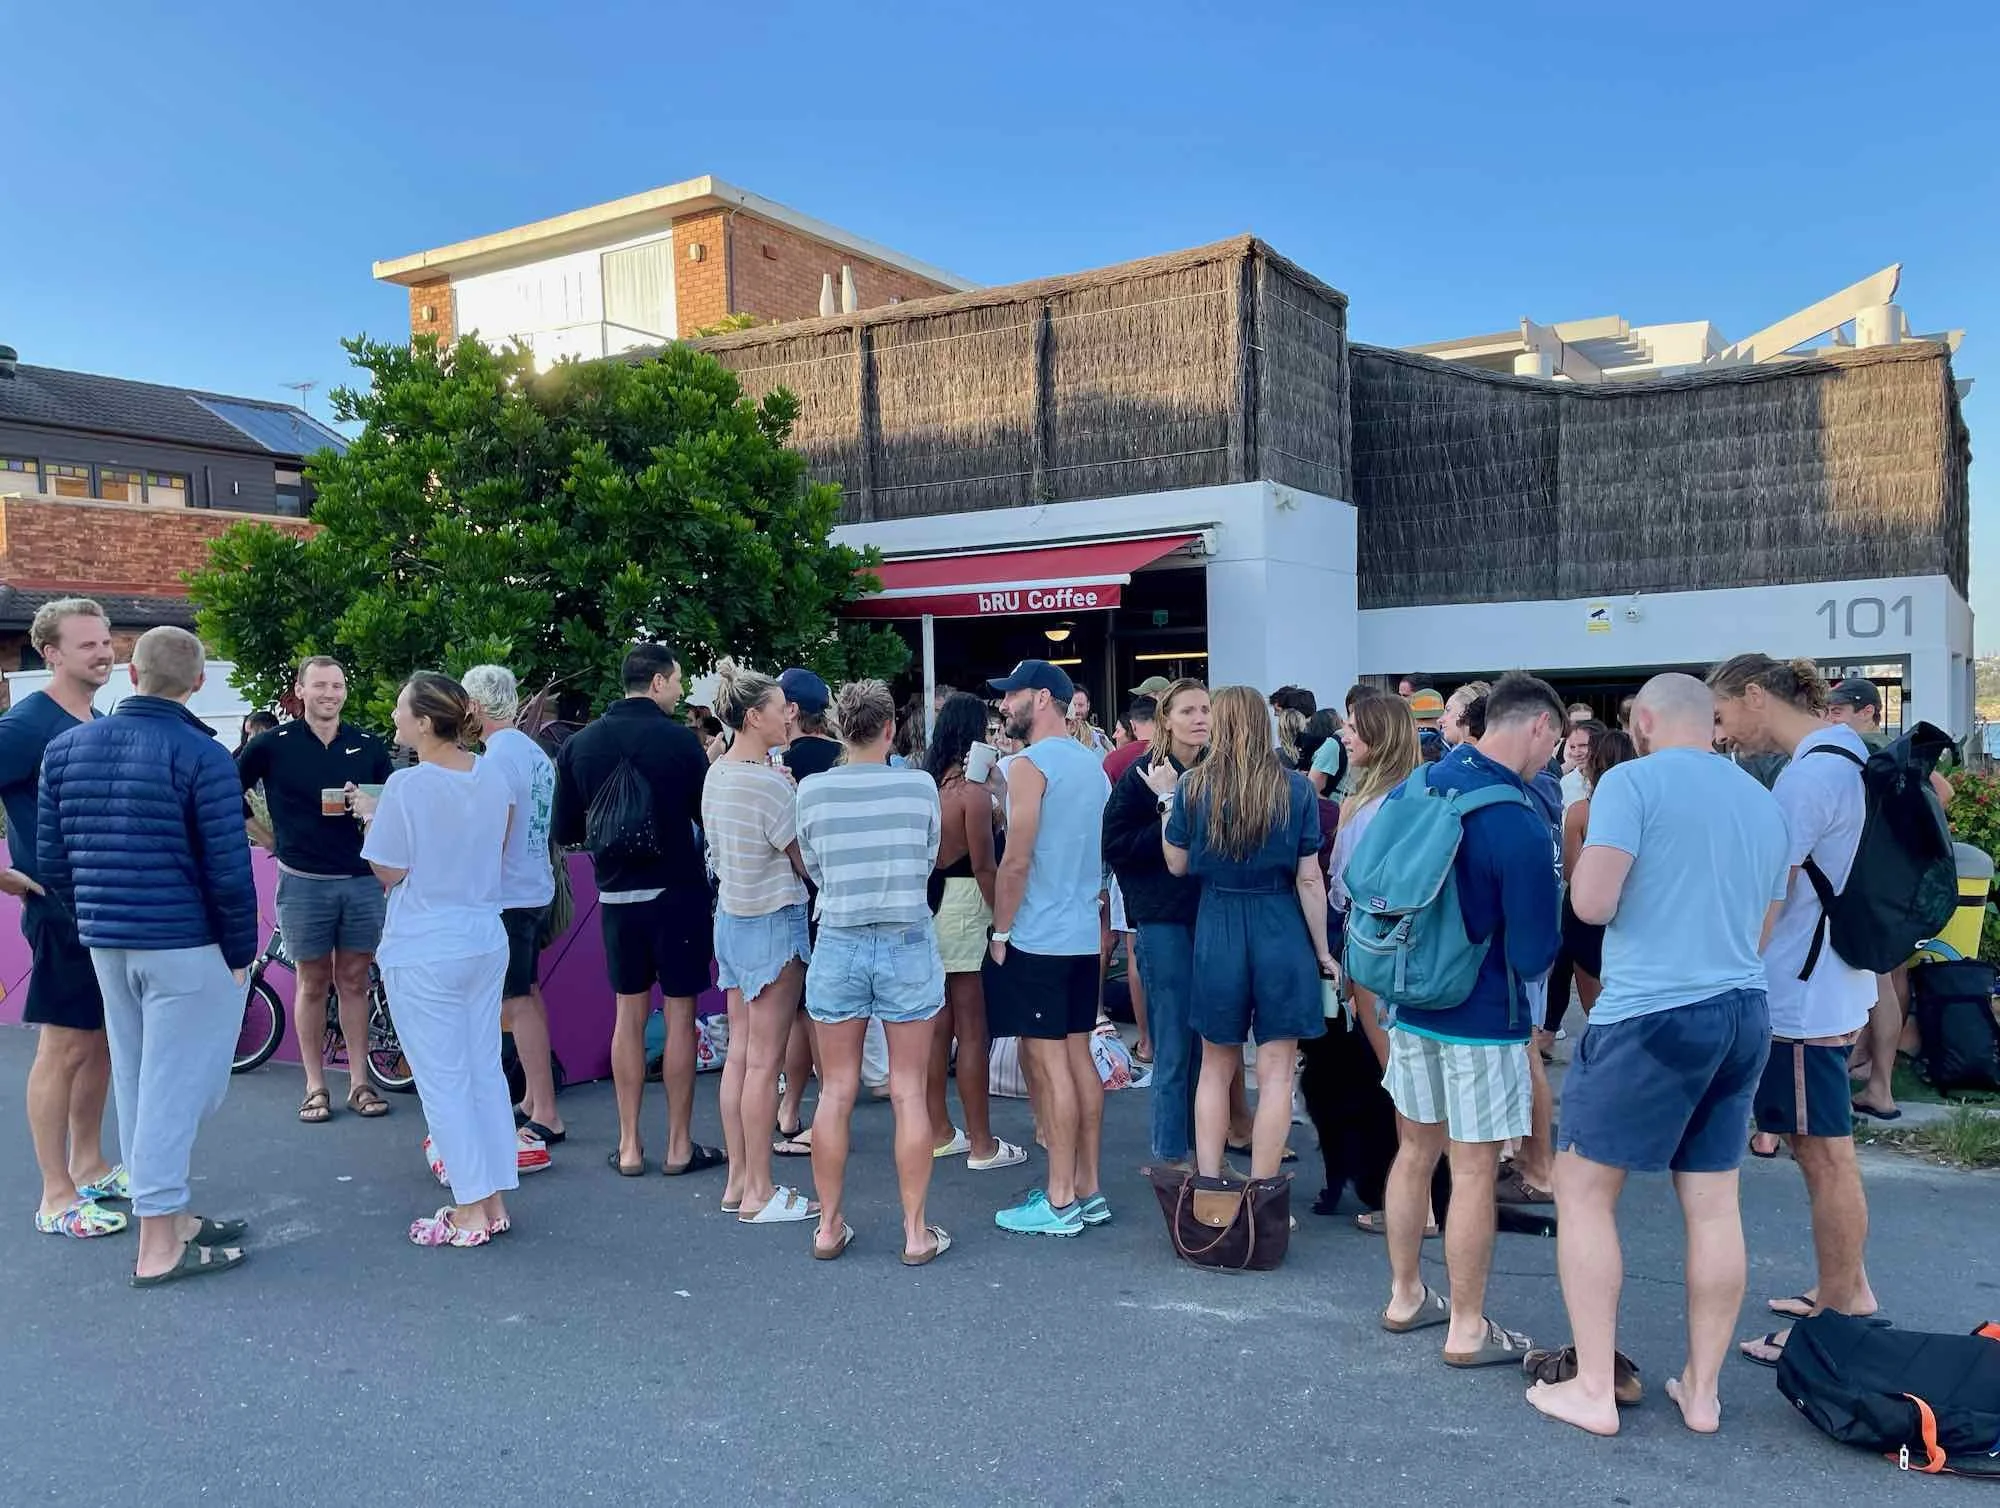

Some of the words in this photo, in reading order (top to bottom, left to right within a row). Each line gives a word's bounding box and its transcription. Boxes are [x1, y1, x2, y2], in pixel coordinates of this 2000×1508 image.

[978, 591, 1020, 613] bRU
[1027, 588, 1098, 610] Coffee
[1815, 595, 1913, 641] 101
